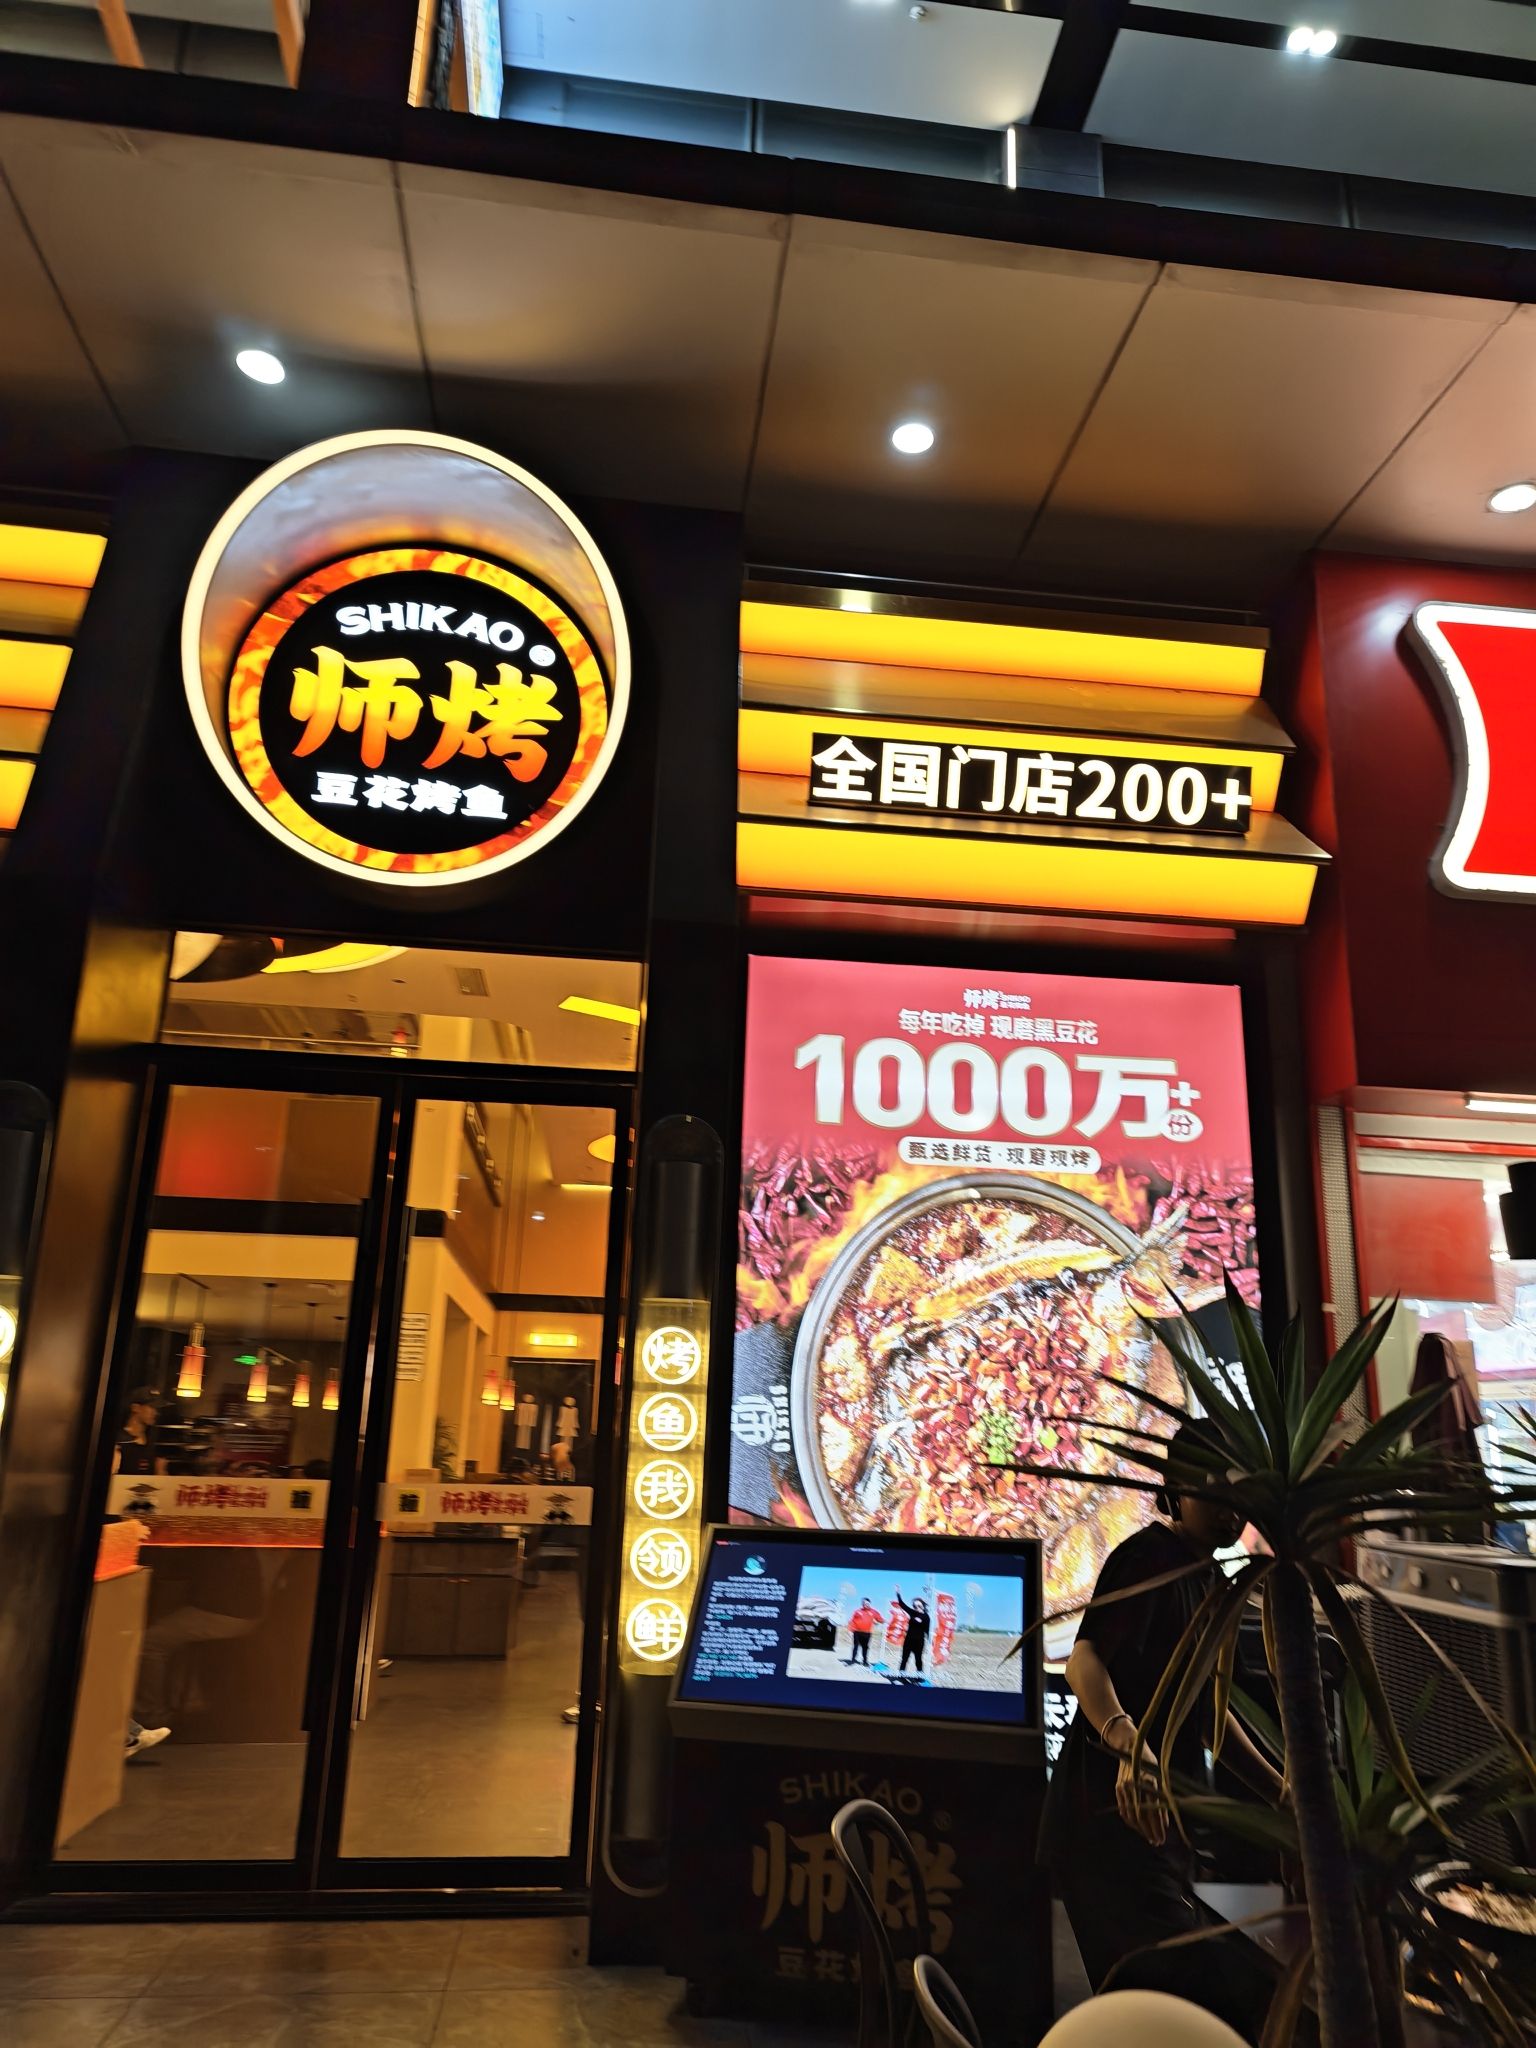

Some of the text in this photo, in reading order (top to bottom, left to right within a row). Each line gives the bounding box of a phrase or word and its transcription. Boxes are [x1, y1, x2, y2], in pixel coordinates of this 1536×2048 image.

[336, 602, 525, 652] SHIKAO
[289, 645, 563, 783] 师烤
[311, 771, 508, 820] 豆花烤鱼
[811, 735, 1253, 827] 全国门店200+
[990, 1014, 1099, 1045] 现磨黑豆花
[633, 1335, 699, 1653] 烤鱼我领鲜
[778, 1769, 924, 1815] SHIKAO
